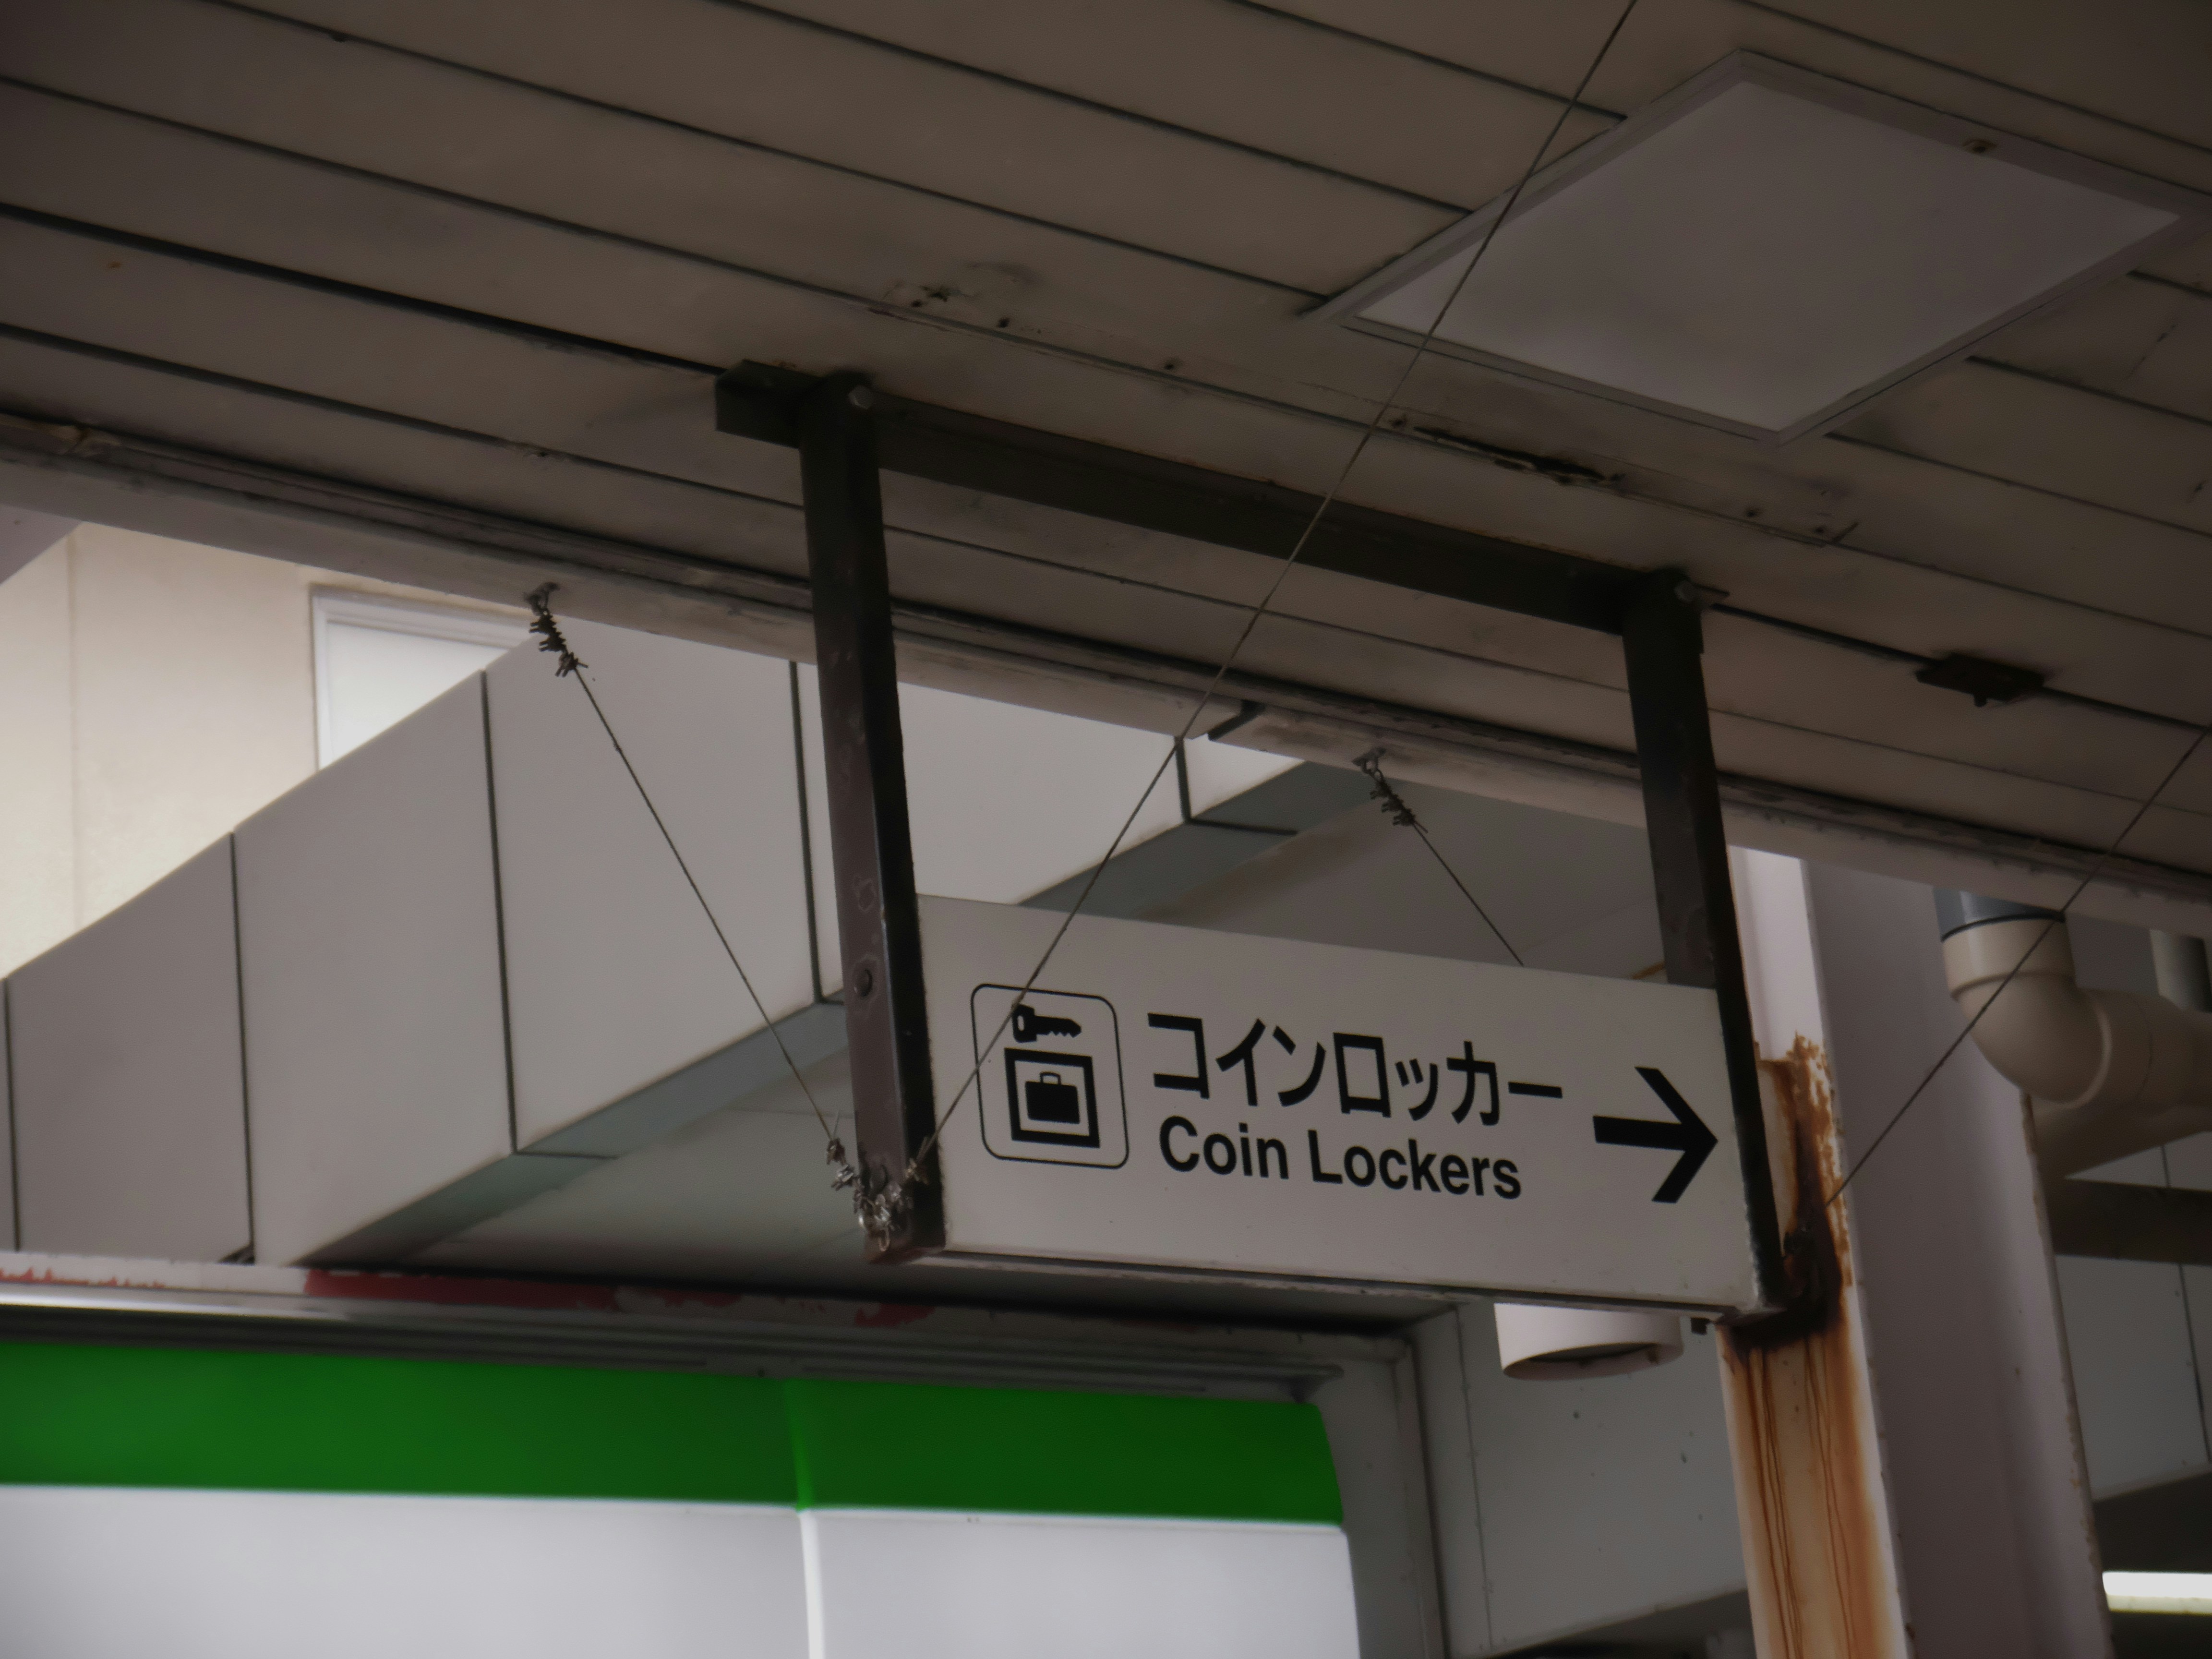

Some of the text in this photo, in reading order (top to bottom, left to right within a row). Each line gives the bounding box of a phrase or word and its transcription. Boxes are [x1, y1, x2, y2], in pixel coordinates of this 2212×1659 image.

[1147, 1012, 1564, 1127] コインロッカー
[1159, 1115, 1522, 1200] Coin Lockers
